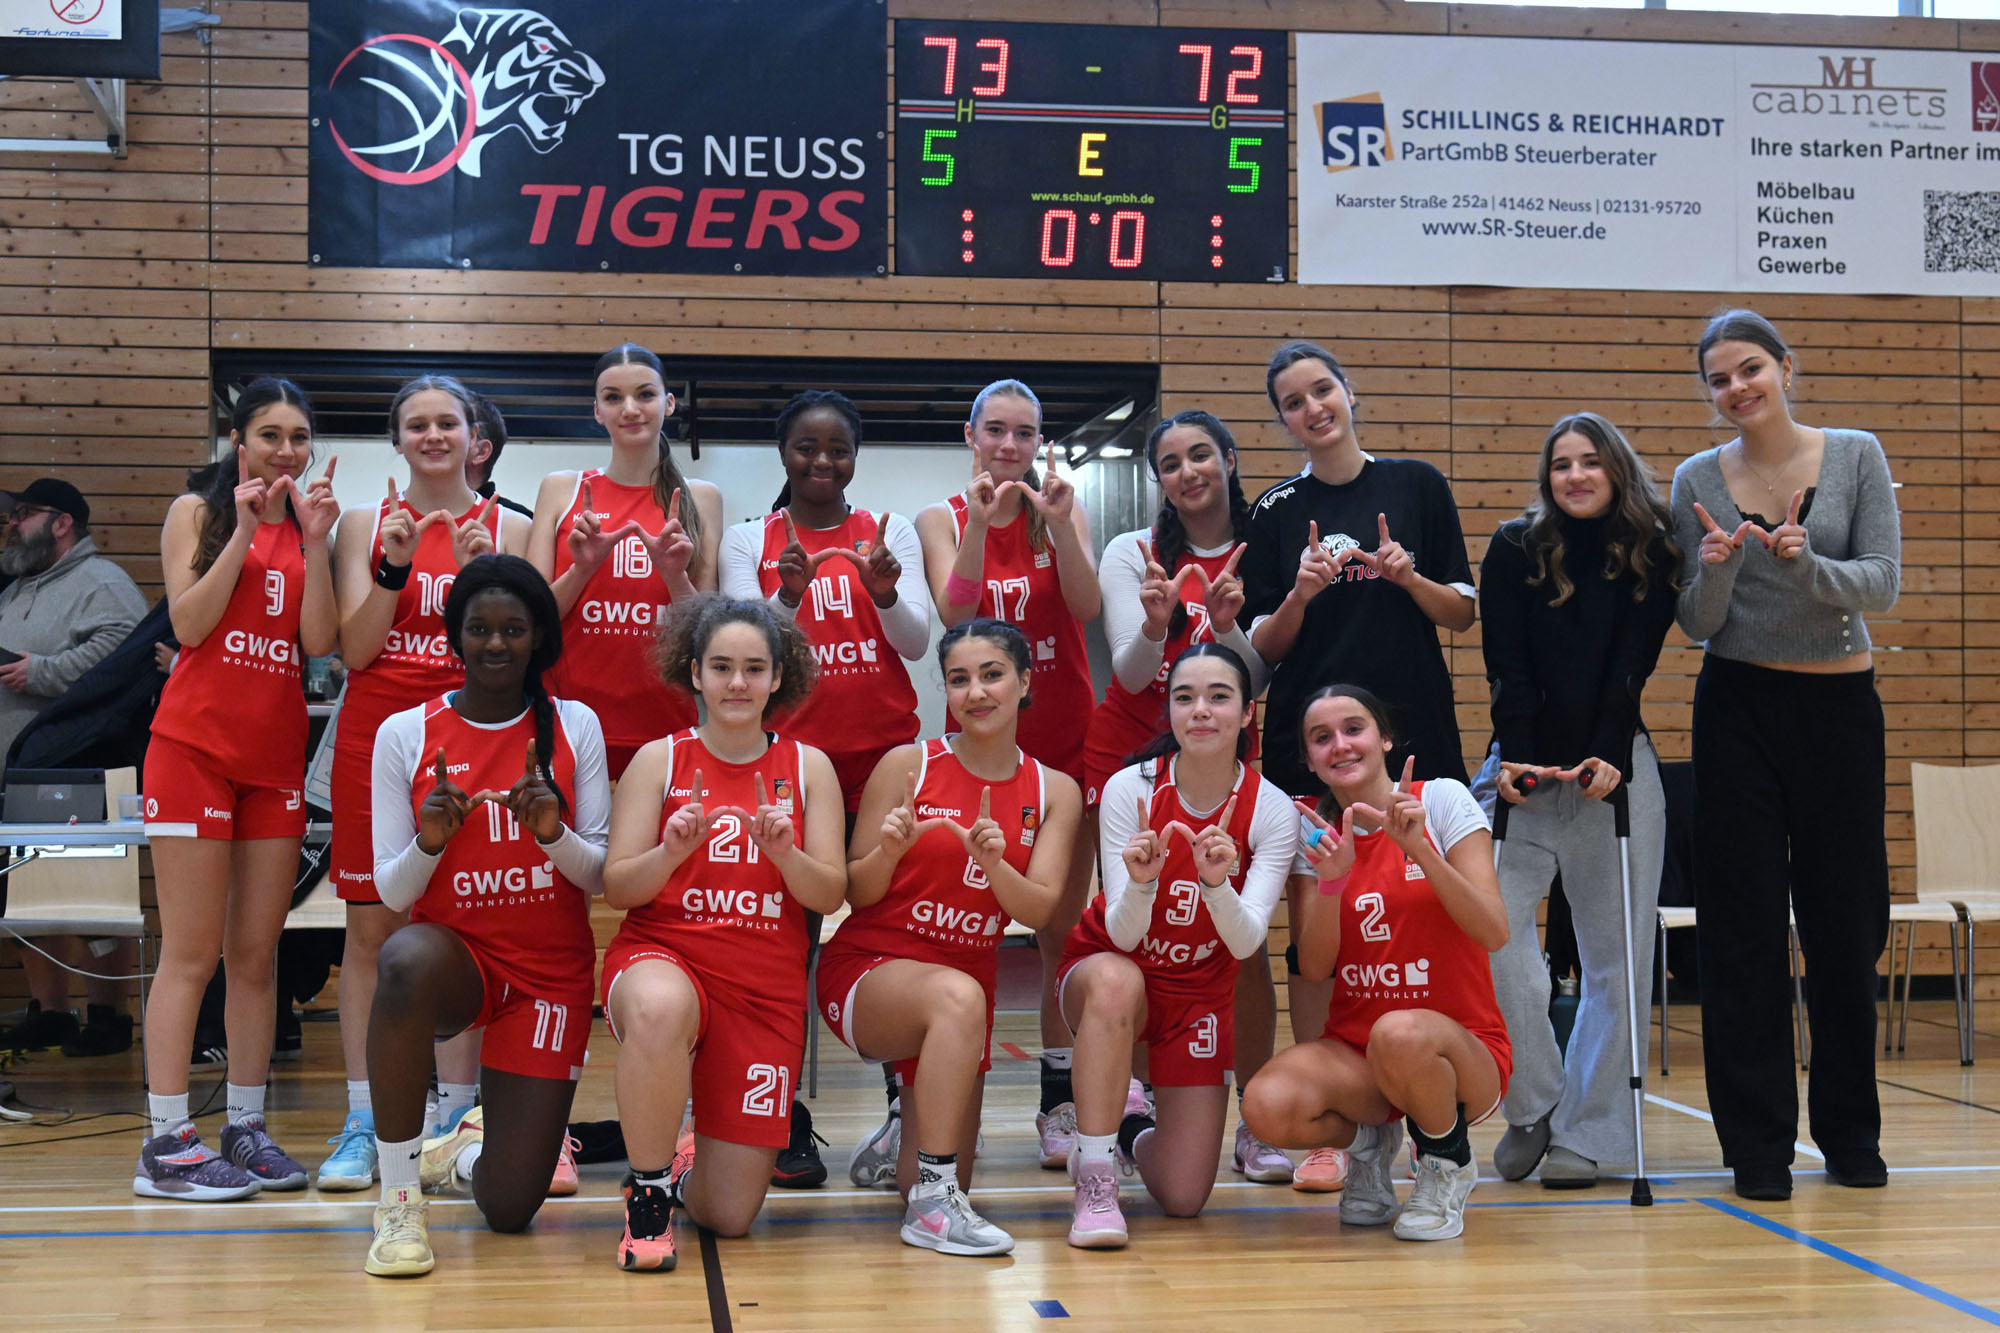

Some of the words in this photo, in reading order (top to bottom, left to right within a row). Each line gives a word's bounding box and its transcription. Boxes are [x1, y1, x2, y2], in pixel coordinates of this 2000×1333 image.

[924, 37, 1008, 96] 73
[1179, 44, 1262, 103] 72
[1819, 56, 1876, 88] MH
[957, 98, 974, 123] H
[1752, 87, 1946, 118] cabinets
[1211, 105, 1227, 129] G
[1402, 109, 1541, 132] SCHILLINGS
[1548, 113, 1564, 132] &
[1573, 114, 1725, 137] REICHHARDT
[618, 133, 683, 176] TG
[705, 135, 866, 180] NEUSS
[921, 129, 957, 186] 5
[1078, 132, 1107, 176] E
[1327, 125, 1387, 167] SR
[1402, 141, 1508, 162] PartGmbB
[1514, 144, 1657, 166] Steuerberater
[1751, 137, 1793, 157] Ihre
[1800, 138, 1882, 158] starken
[1890, 140, 1969, 161] Partner
[1976, 142, 2000, 161] im
[1227, 137, 1262, 193] 5
[1032, 191, 1155, 205] www.schauf-gmbh.de
[1336, 194, 1396, 208] Kaarster
[1400, 195, 1447, 209] Straße
[1452, 195, 1488, 209] 252a
[1499, 197, 1544, 211] 41462
[1549, 198, 1592, 212] Neuss
[1603, 200, 1702, 215] 02131-95720
[1757, 181, 1855, 200] Möbelbau
[520, 184, 865, 251] TIGERS
[1422, 218, 1607, 240] www.SR-Steuer.de
[1757, 206, 1834, 224] Küchen
[1757, 231, 1827, 249] Praxen
[1758, 256, 1847, 274] Gewerbe
[1261, 486, 1296, 509] Kempa
[613, 535, 653, 578] 18
[265, 569, 285, 616] 9
[417, 571, 457, 616] 10
[808, 575, 853, 621] 14
[987, 576, 1030, 621] 17
[582, 600, 651, 624] GWG
[1187, 601, 1210, 645] 7
[225, 630, 289, 662] GWG
[385, 630, 448, 656] GWG
[582, 627, 657, 637] WOHNFÜHL
[810, 641, 857, 665] WG
[814, 667, 881, 677] HNFÜHLEN
[426, 763, 470, 777] Kmpa
[204, 807, 232, 822] Kempa
[918, 804, 961, 819] Kempa
[709, 815, 759, 864] 21
[340, 869, 372, 883] Kempa
[453, 867, 526, 896] GWG
[456, 892, 555, 908] WOHNFÜHLEN
[682, 888, 757, 915] GWG
[1165, 880, 1200, 926] 3
[684, 913, 779, 931] WOHNFÜHLEN
[911, 900, 983, 934] GWG
[1355, 892, 1391, 942] 2
[1142, 934, 1191, 963] WG
[1341, 963, 1400, 988] GWG
[532, 998, 568, 1052] 11
[1189, 1012, 1217, 1058] 3
[742, 1063, 789, 1117] 21
